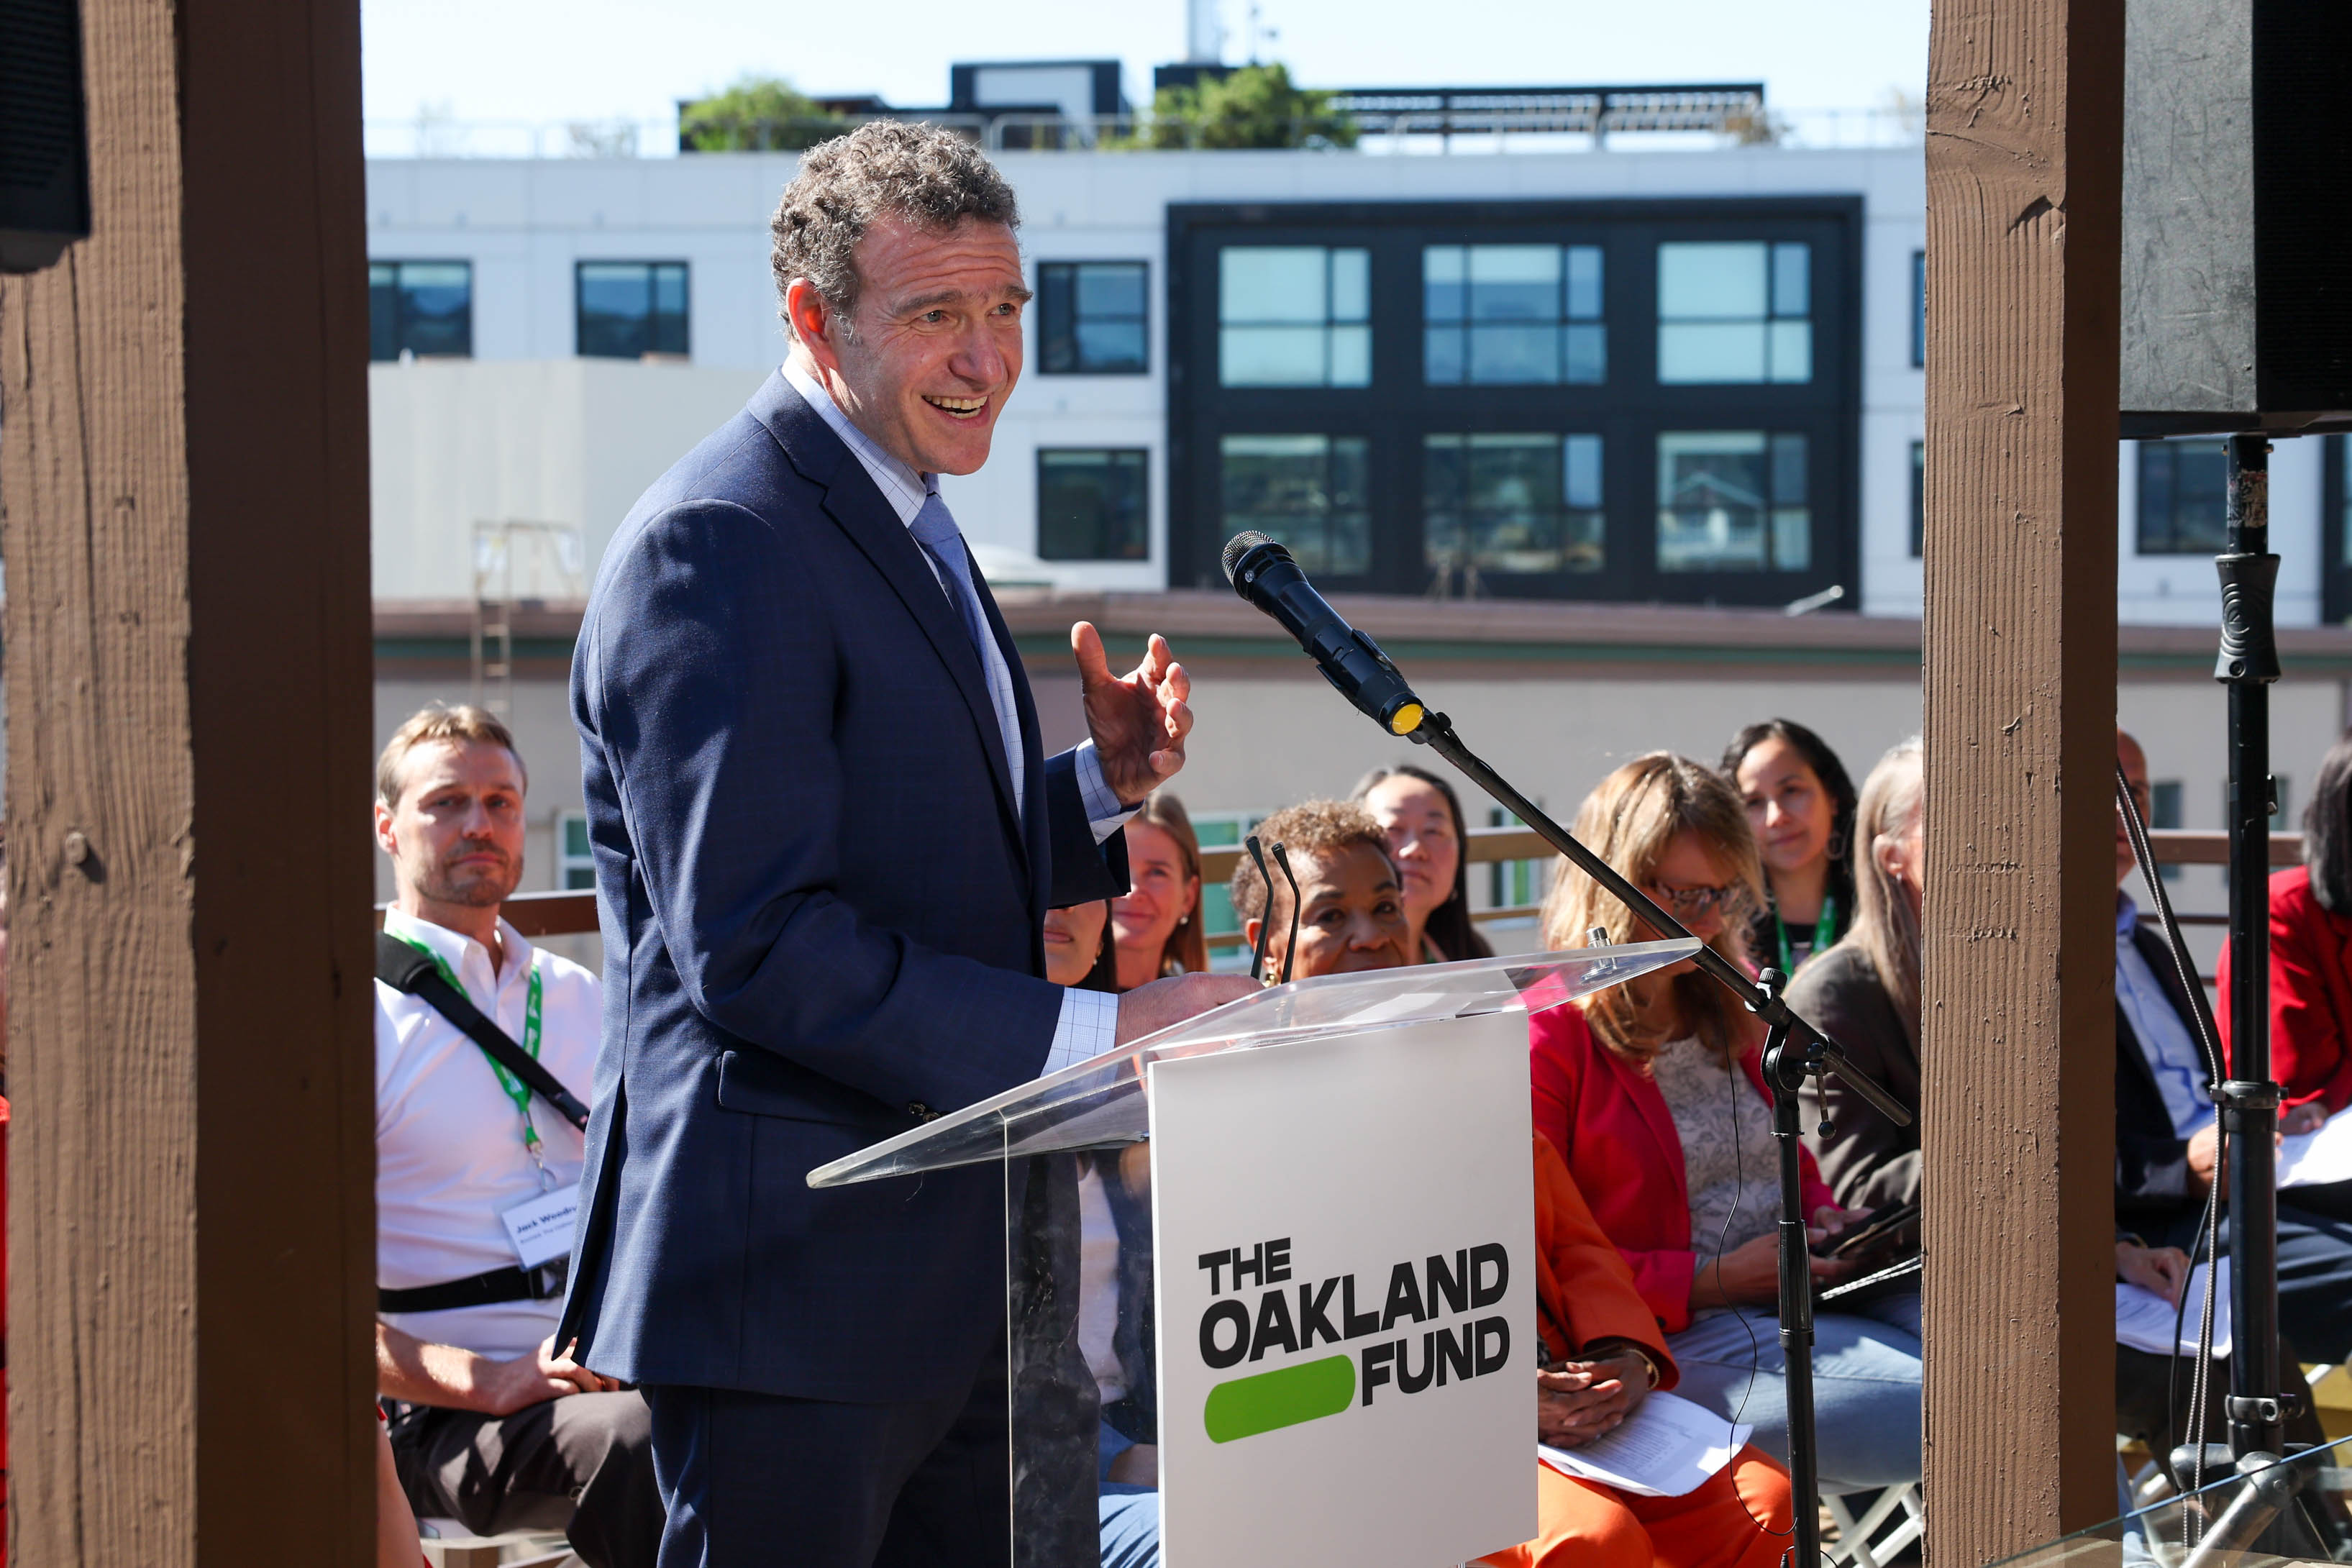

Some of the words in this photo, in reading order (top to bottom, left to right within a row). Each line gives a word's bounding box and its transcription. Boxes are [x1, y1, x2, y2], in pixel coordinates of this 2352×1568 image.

[1198, 1237, 1291, 1295] THE
[1199, 1243, 1509, 1369] OAKLAND
[1362, 1316, 1510, 1407] FUND
